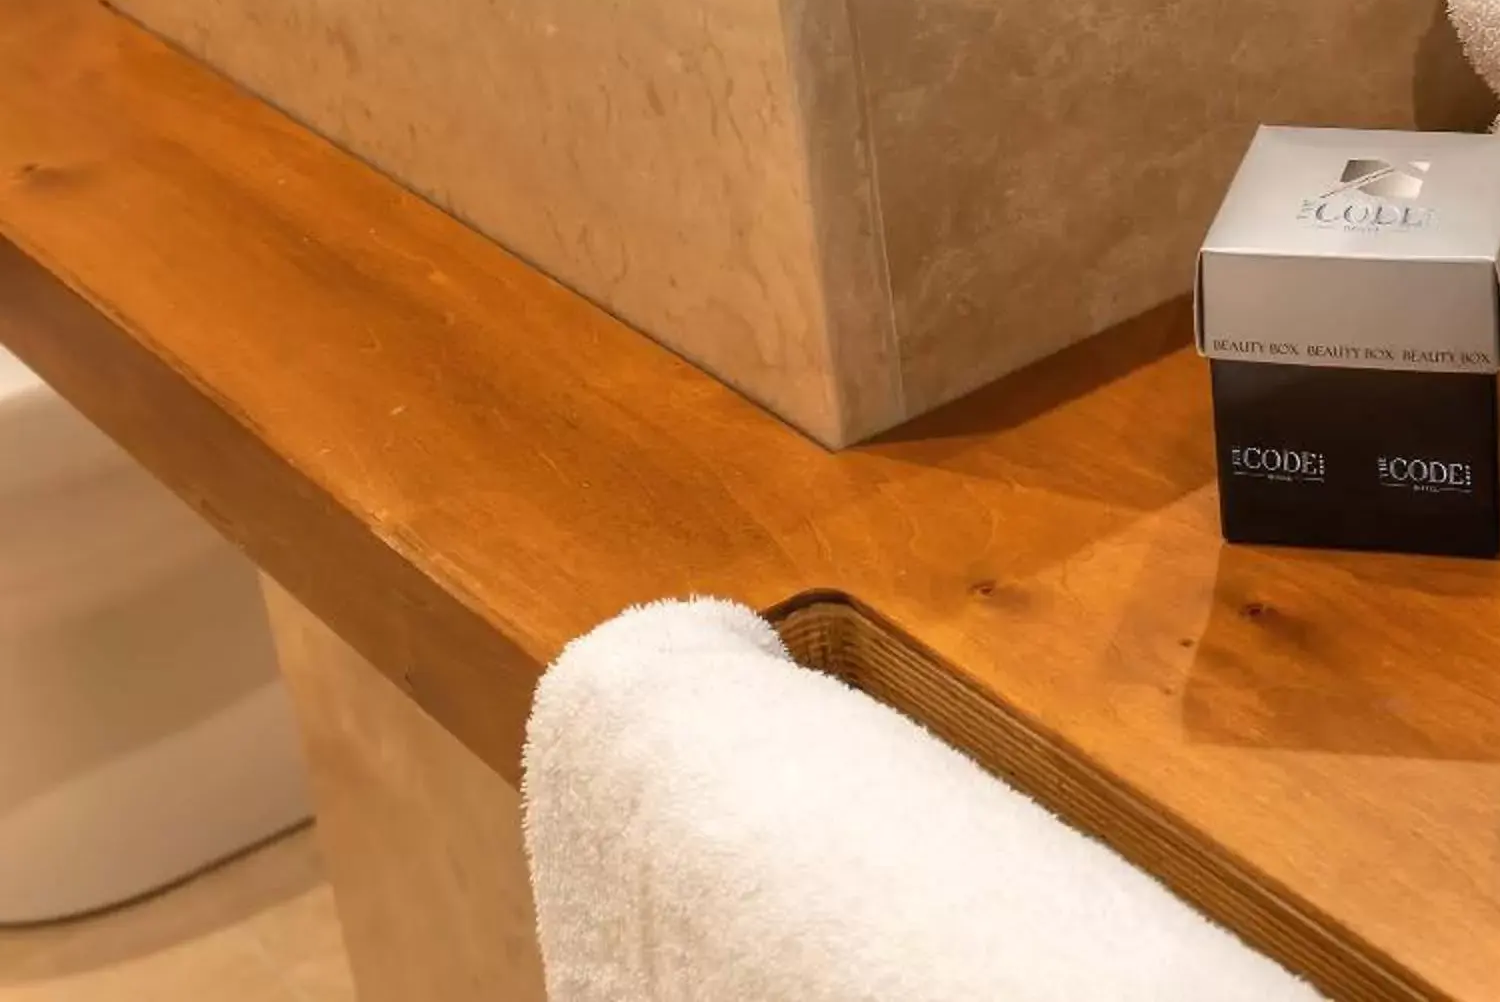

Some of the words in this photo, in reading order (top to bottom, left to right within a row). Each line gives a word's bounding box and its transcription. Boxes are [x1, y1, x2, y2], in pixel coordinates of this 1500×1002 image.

[1213, 339, 1263, 354] BEAUTY
[1269, 341, 1300, 356] BOX
[1306, 344, 1360, 359] BEAUTY
[1364, 347, 1394, 360] BOX
[1402, 349, 1455, 363] BEAUTY
[1461, 351, 1490, 365] BOX
[1243, 447, 1317, 475] CODE
[1390, 457, 1465, 485] CODE
